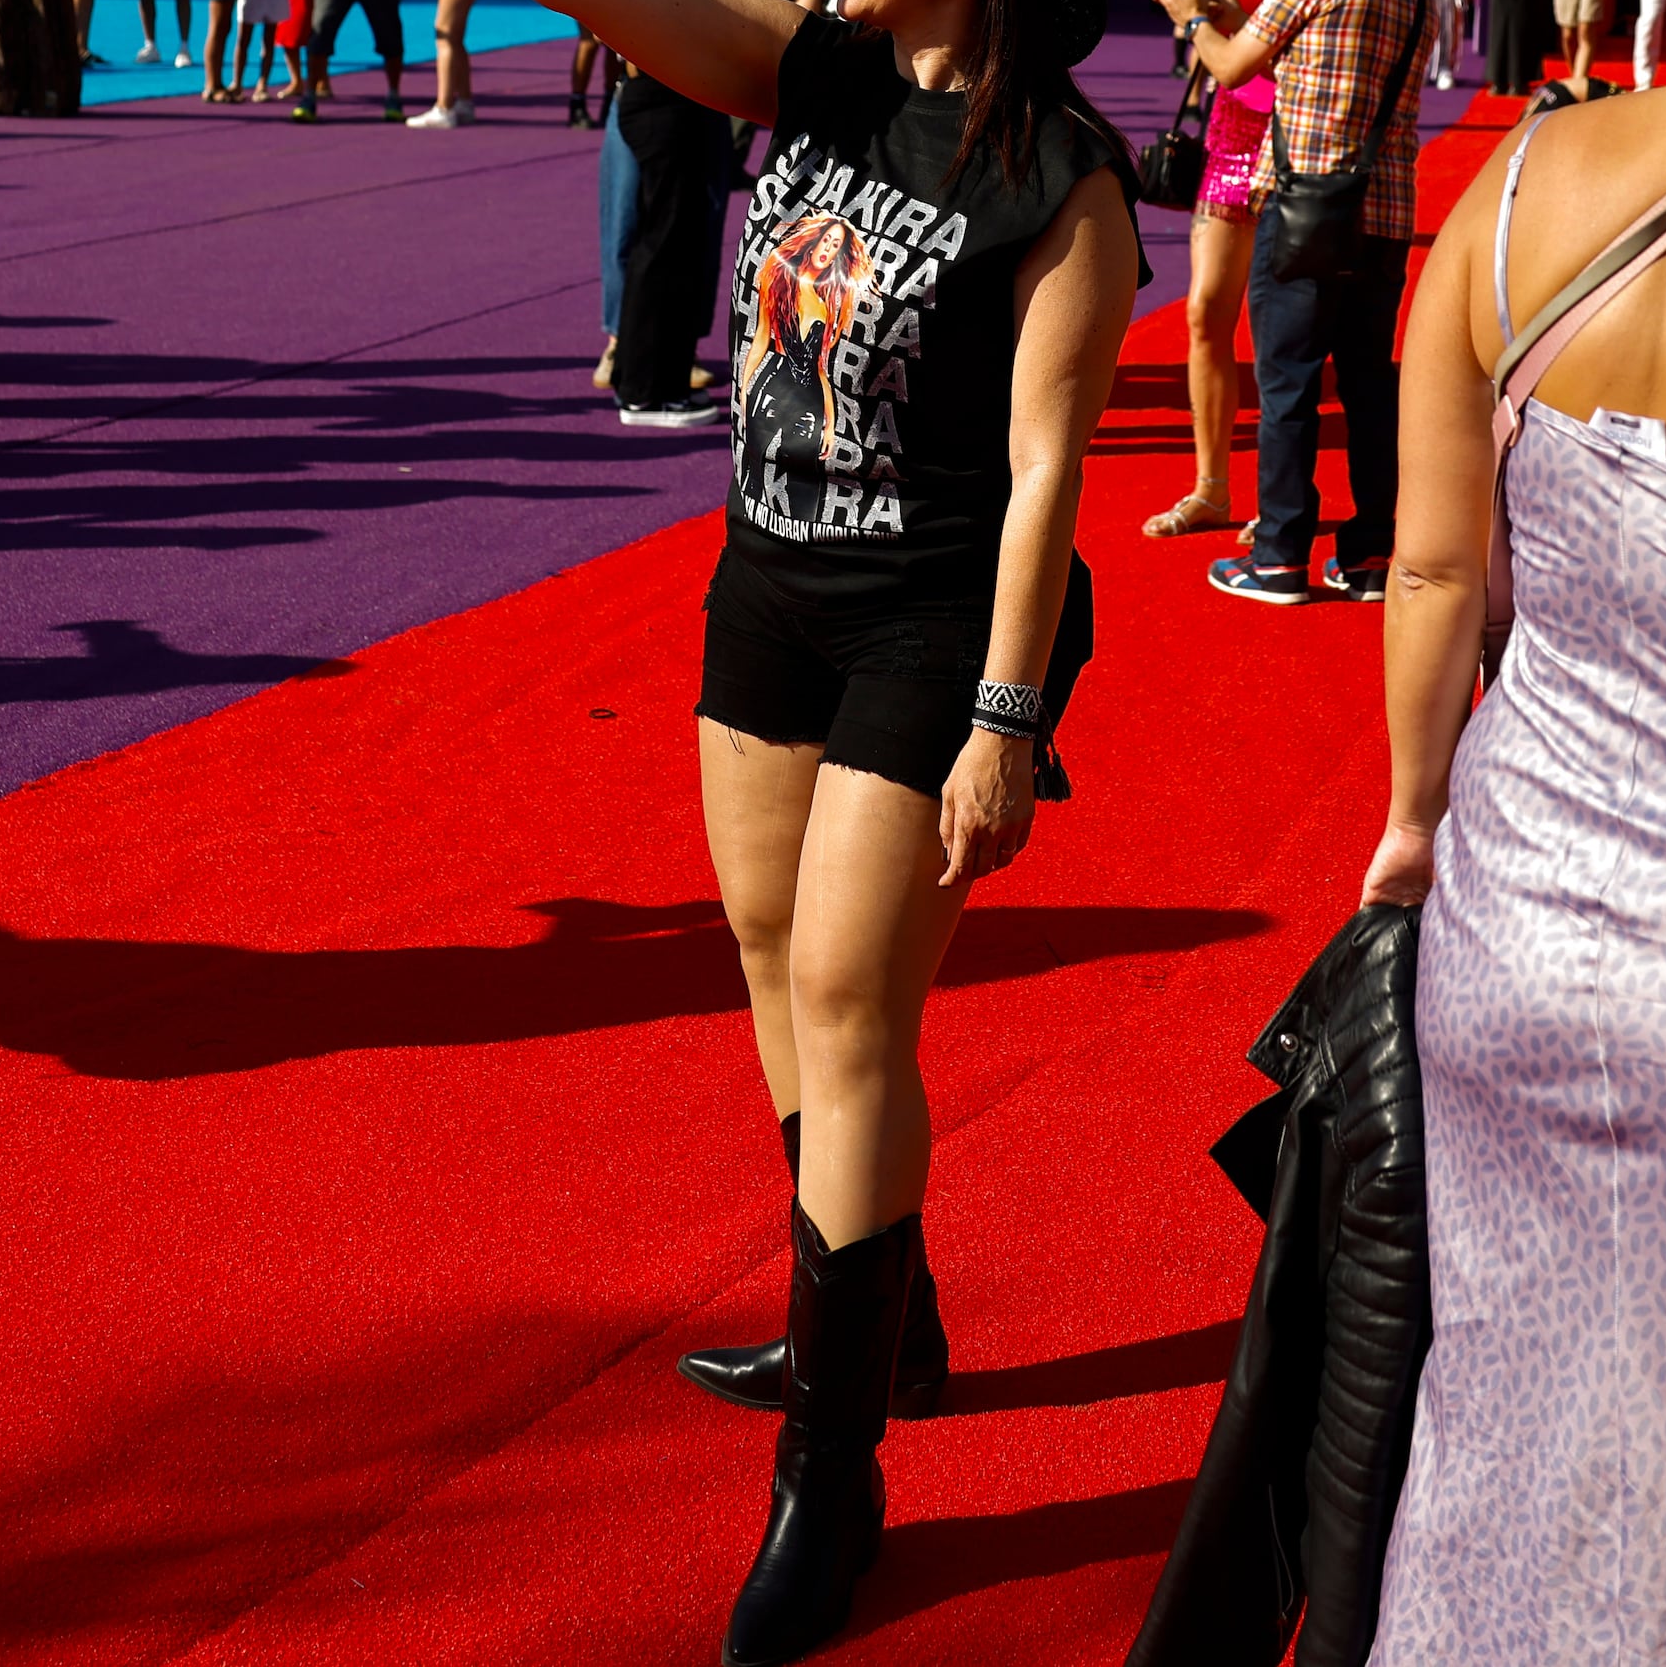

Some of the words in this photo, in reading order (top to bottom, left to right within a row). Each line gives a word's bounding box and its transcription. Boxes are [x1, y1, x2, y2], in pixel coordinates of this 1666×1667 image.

[776, 132, 968, 262] SHAKIRA
[754, 502, 768, 529] NO
[768, 509, 810, 543] LLORAN
